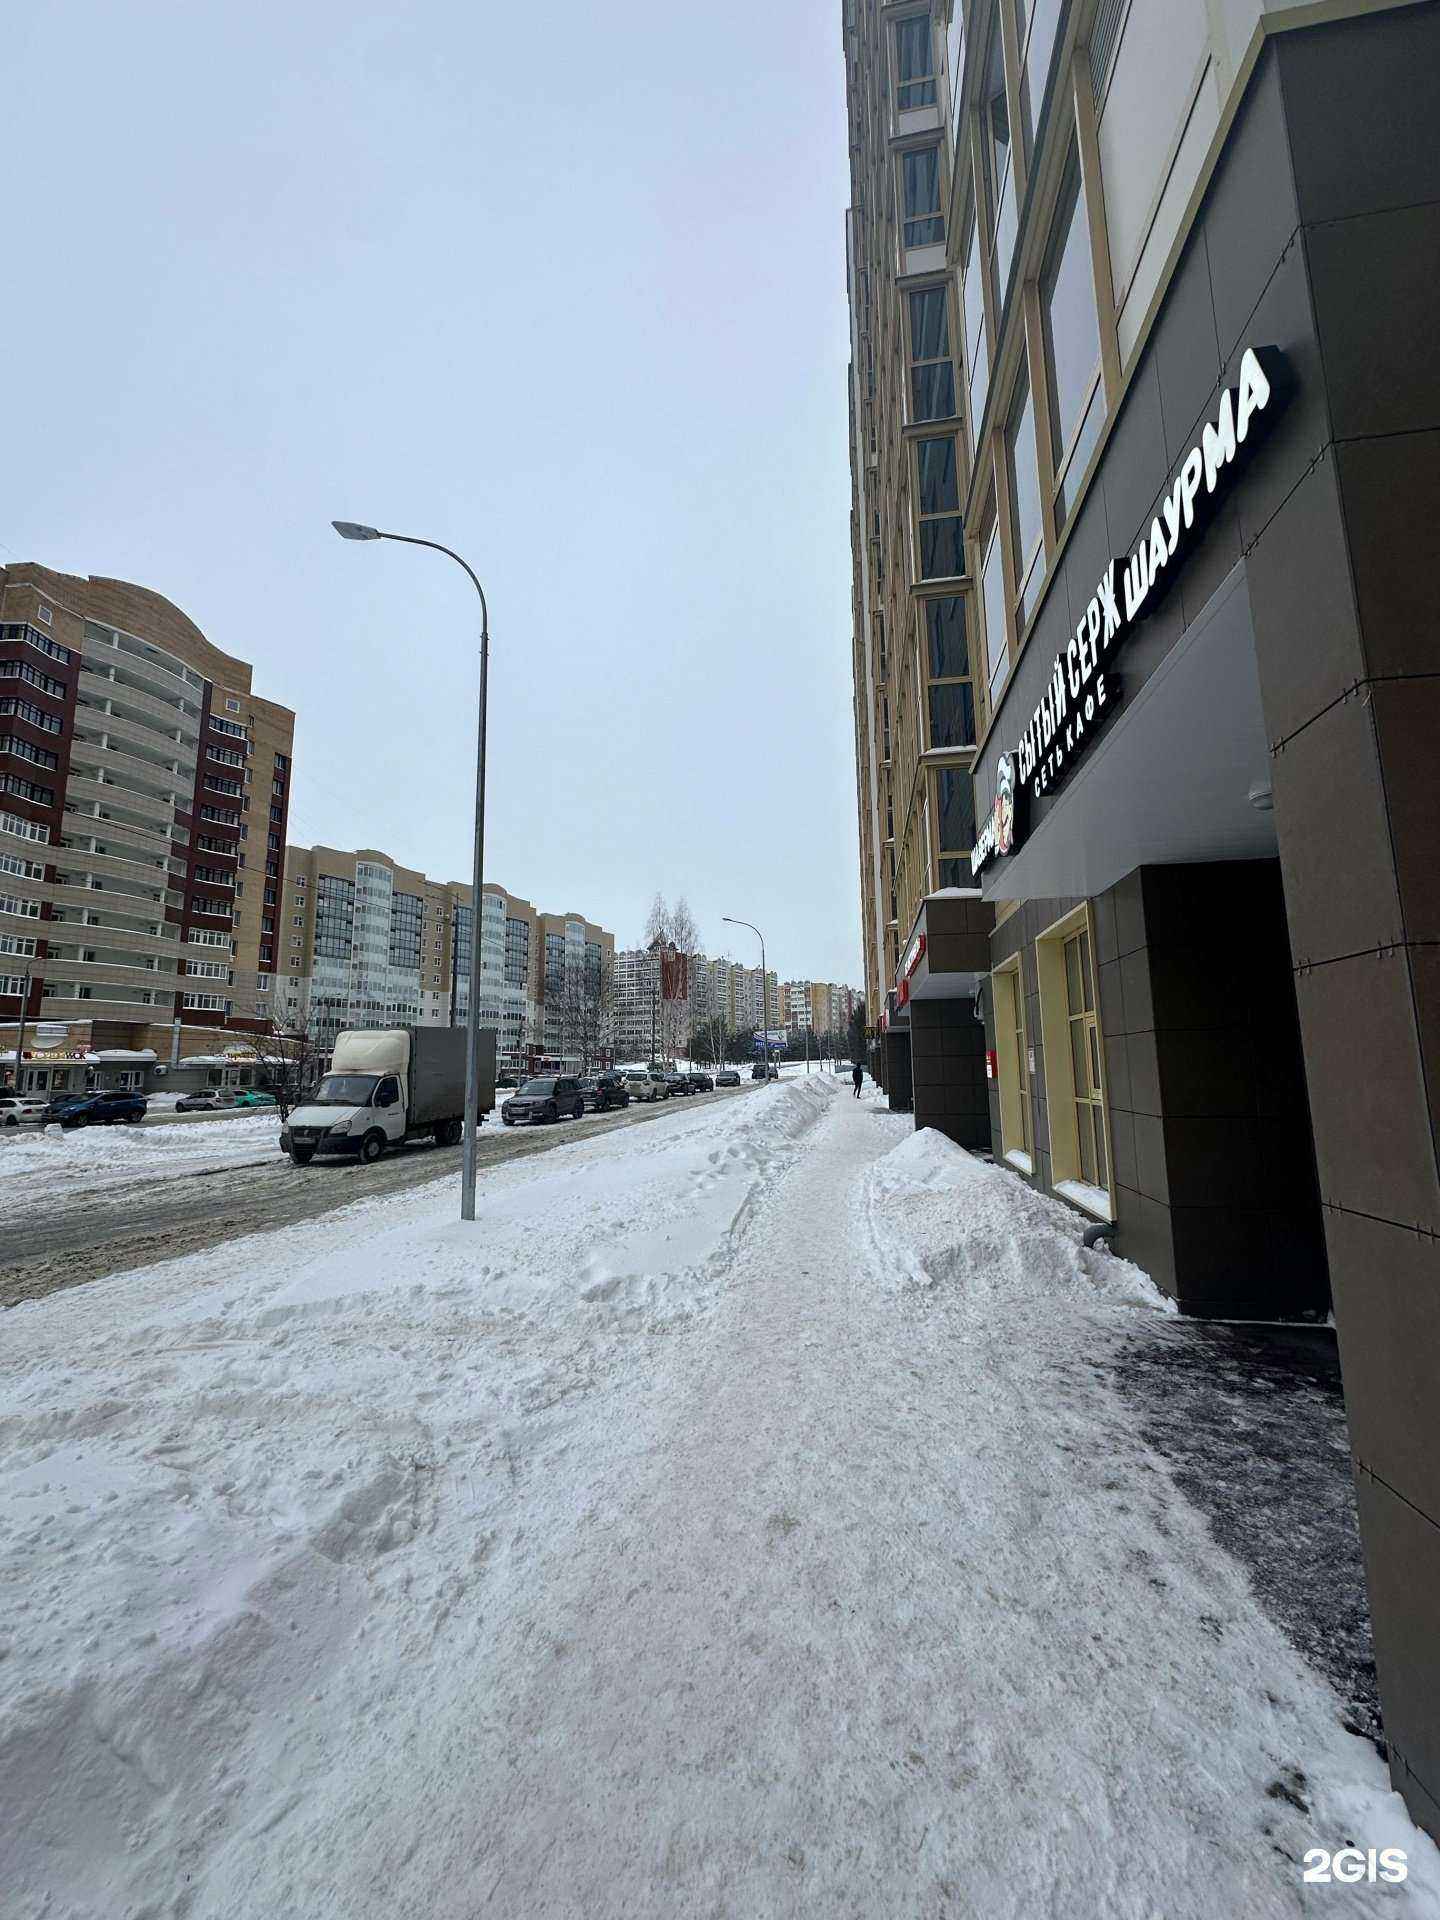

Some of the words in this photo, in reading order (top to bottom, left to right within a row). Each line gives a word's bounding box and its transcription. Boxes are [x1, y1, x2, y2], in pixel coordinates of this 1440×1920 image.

[1018, 654, 1067, 785] СЫТЫЙ
[1067, 558, 1122, 698] СЕРЖ
[1123, 348, 1271, 622] ШАУРМА
[1034, 745, 1064, 798] СЕТЬ
[1066, 674, 1107, 753] КАФЕ
